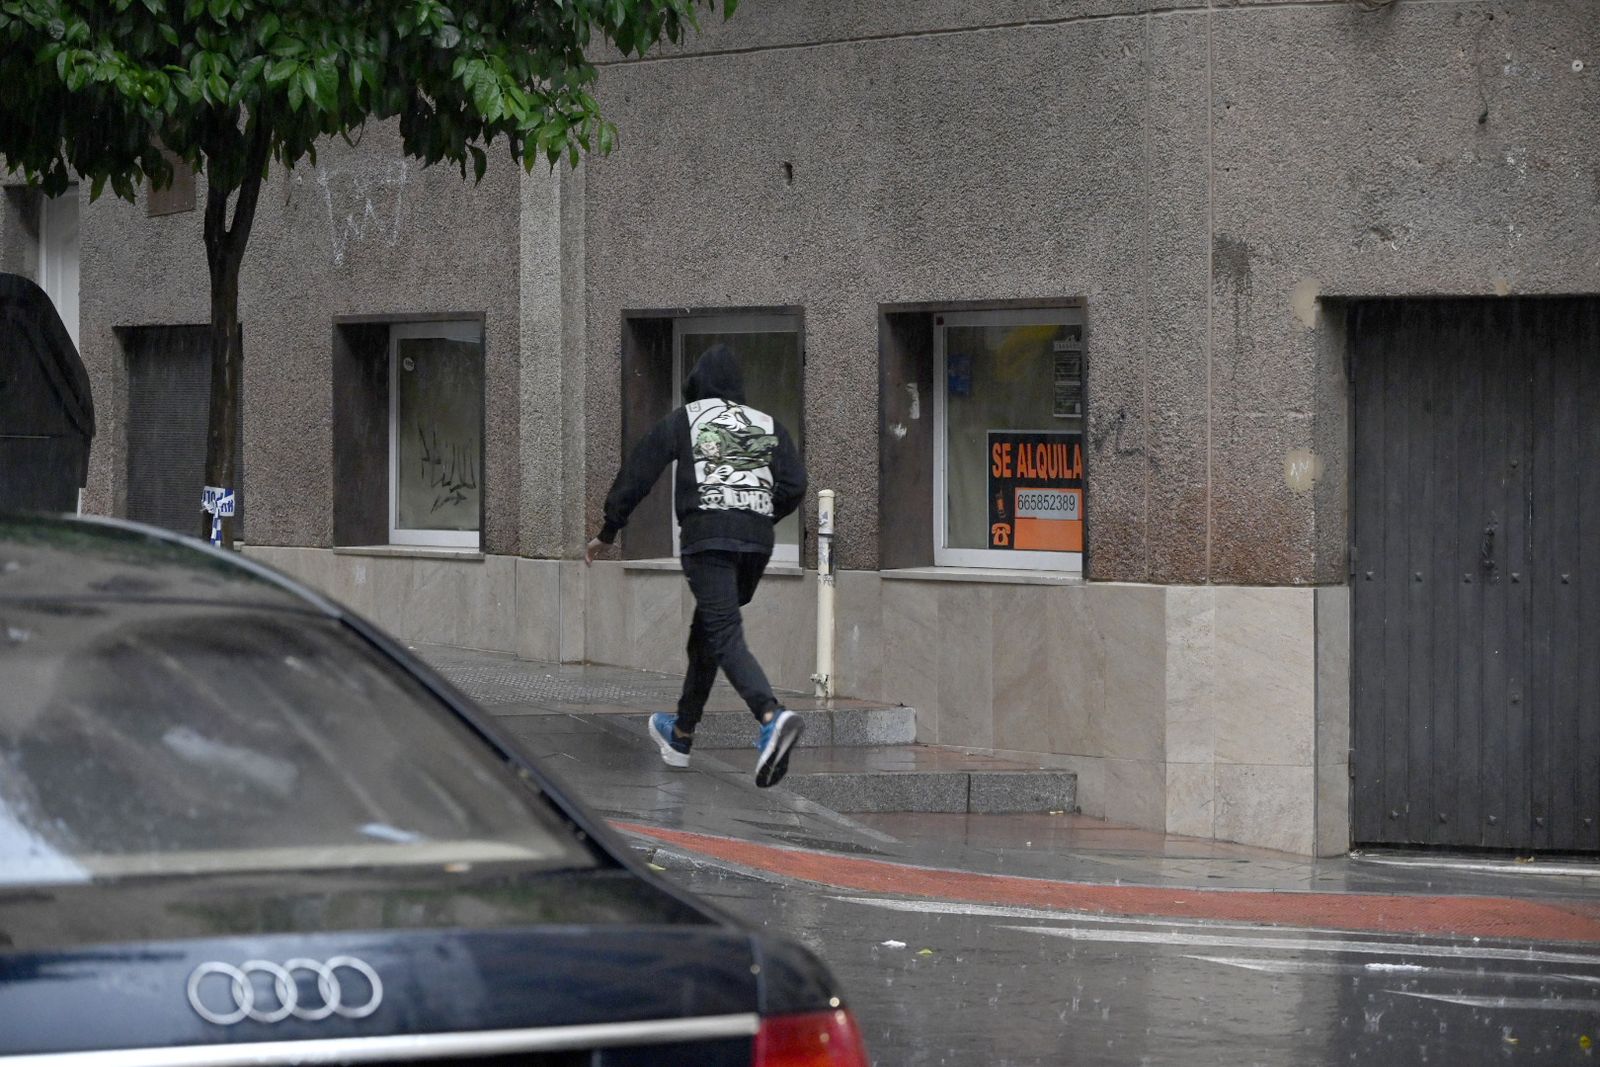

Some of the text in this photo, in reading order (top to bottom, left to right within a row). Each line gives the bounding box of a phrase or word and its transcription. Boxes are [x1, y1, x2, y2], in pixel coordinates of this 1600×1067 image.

[992, 442, 1083, 480] SE ALQUILA
[1017, 494, 1076, 511] 665852389
